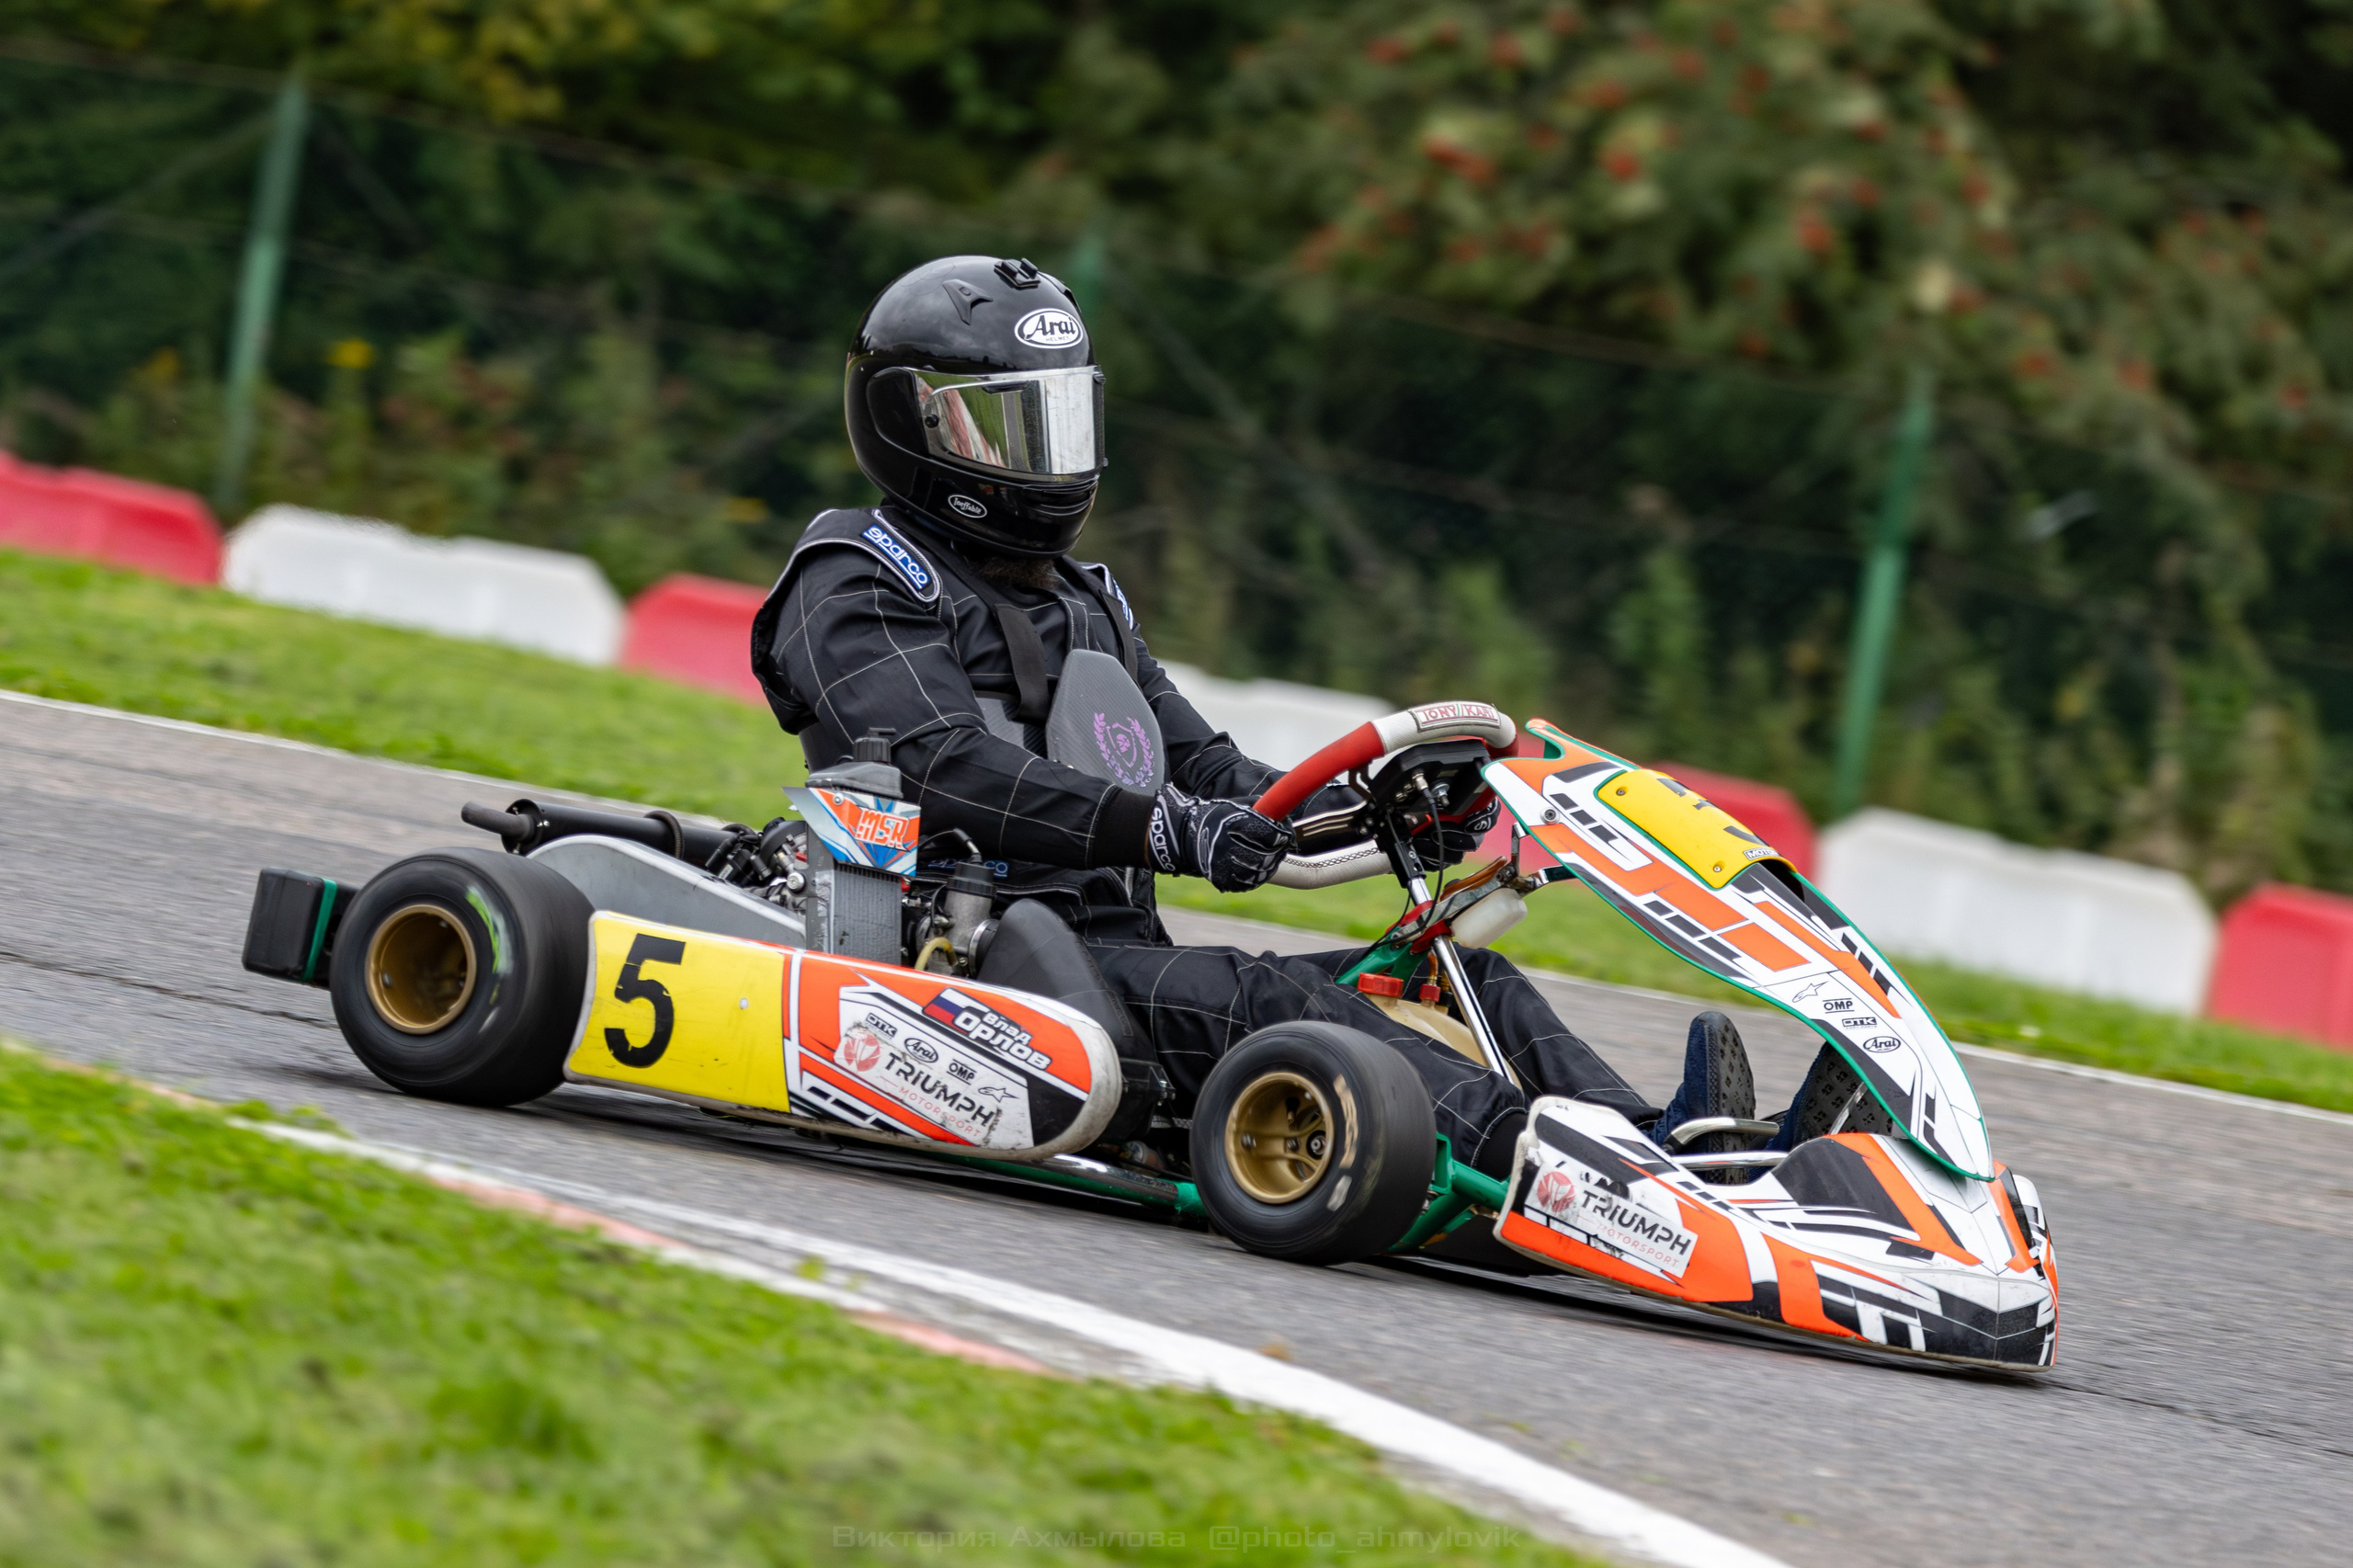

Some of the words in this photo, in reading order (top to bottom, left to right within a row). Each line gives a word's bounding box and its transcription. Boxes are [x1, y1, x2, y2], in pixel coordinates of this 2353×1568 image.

[1025, 314, 1076, 339] Arai
[953, 496, 983, 516] Ineffable
[866, 526, 929, 586] sparco
[1423, 705, 1457, 721] TONY
[1151, 806, 1176, 872] sparco
[604, 933, 686, 1068] 5
[1824, 1000, 1854, 1012] OMP
[867, 1015, 896, 1038] OTK
[982, 1012, 1034, 1046] Влад
[1843, 1017, 1875, 1027] OTK
[907, 1040, 936, 1060] Arai
[1867, 1038, 1896, 1050] Arai
[949, 1062, 976, 1081] OMP
[884, 1051, 996, 1128] TRIUMPH
[898, 1085, 982, 1138] MOTORSPORT
[1581, 1189, 1692, 1256] TRIUMPH
